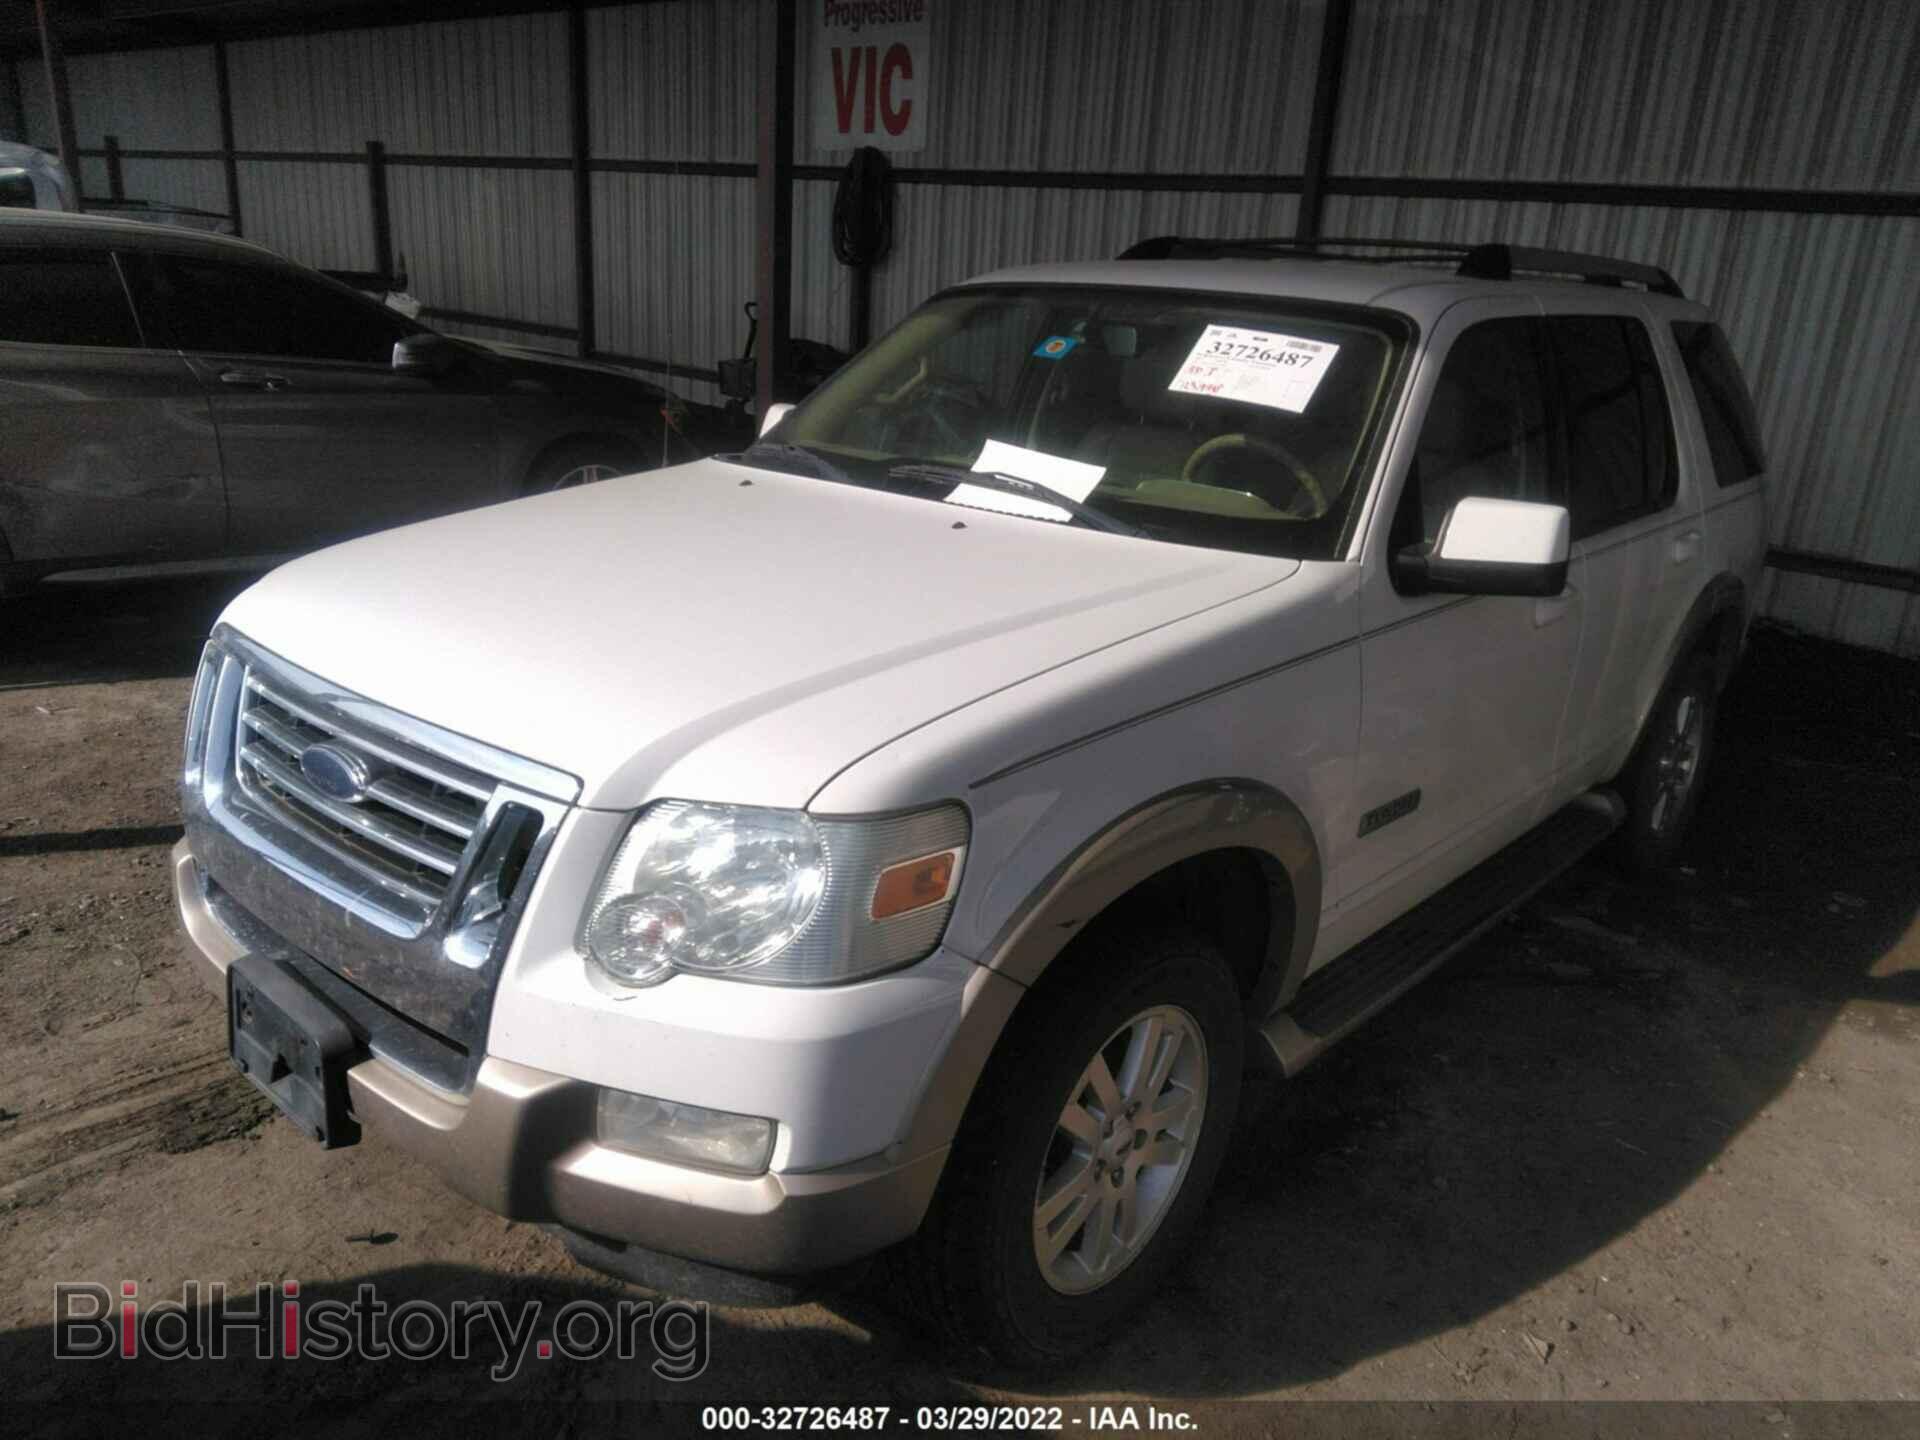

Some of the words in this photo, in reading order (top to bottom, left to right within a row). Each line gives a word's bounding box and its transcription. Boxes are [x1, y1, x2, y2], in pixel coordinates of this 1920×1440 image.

[824, 0, 924, 32] Progressive
[831, 42, 913, 136] VIC
[1206, 341, 1314, 369] 32726487
